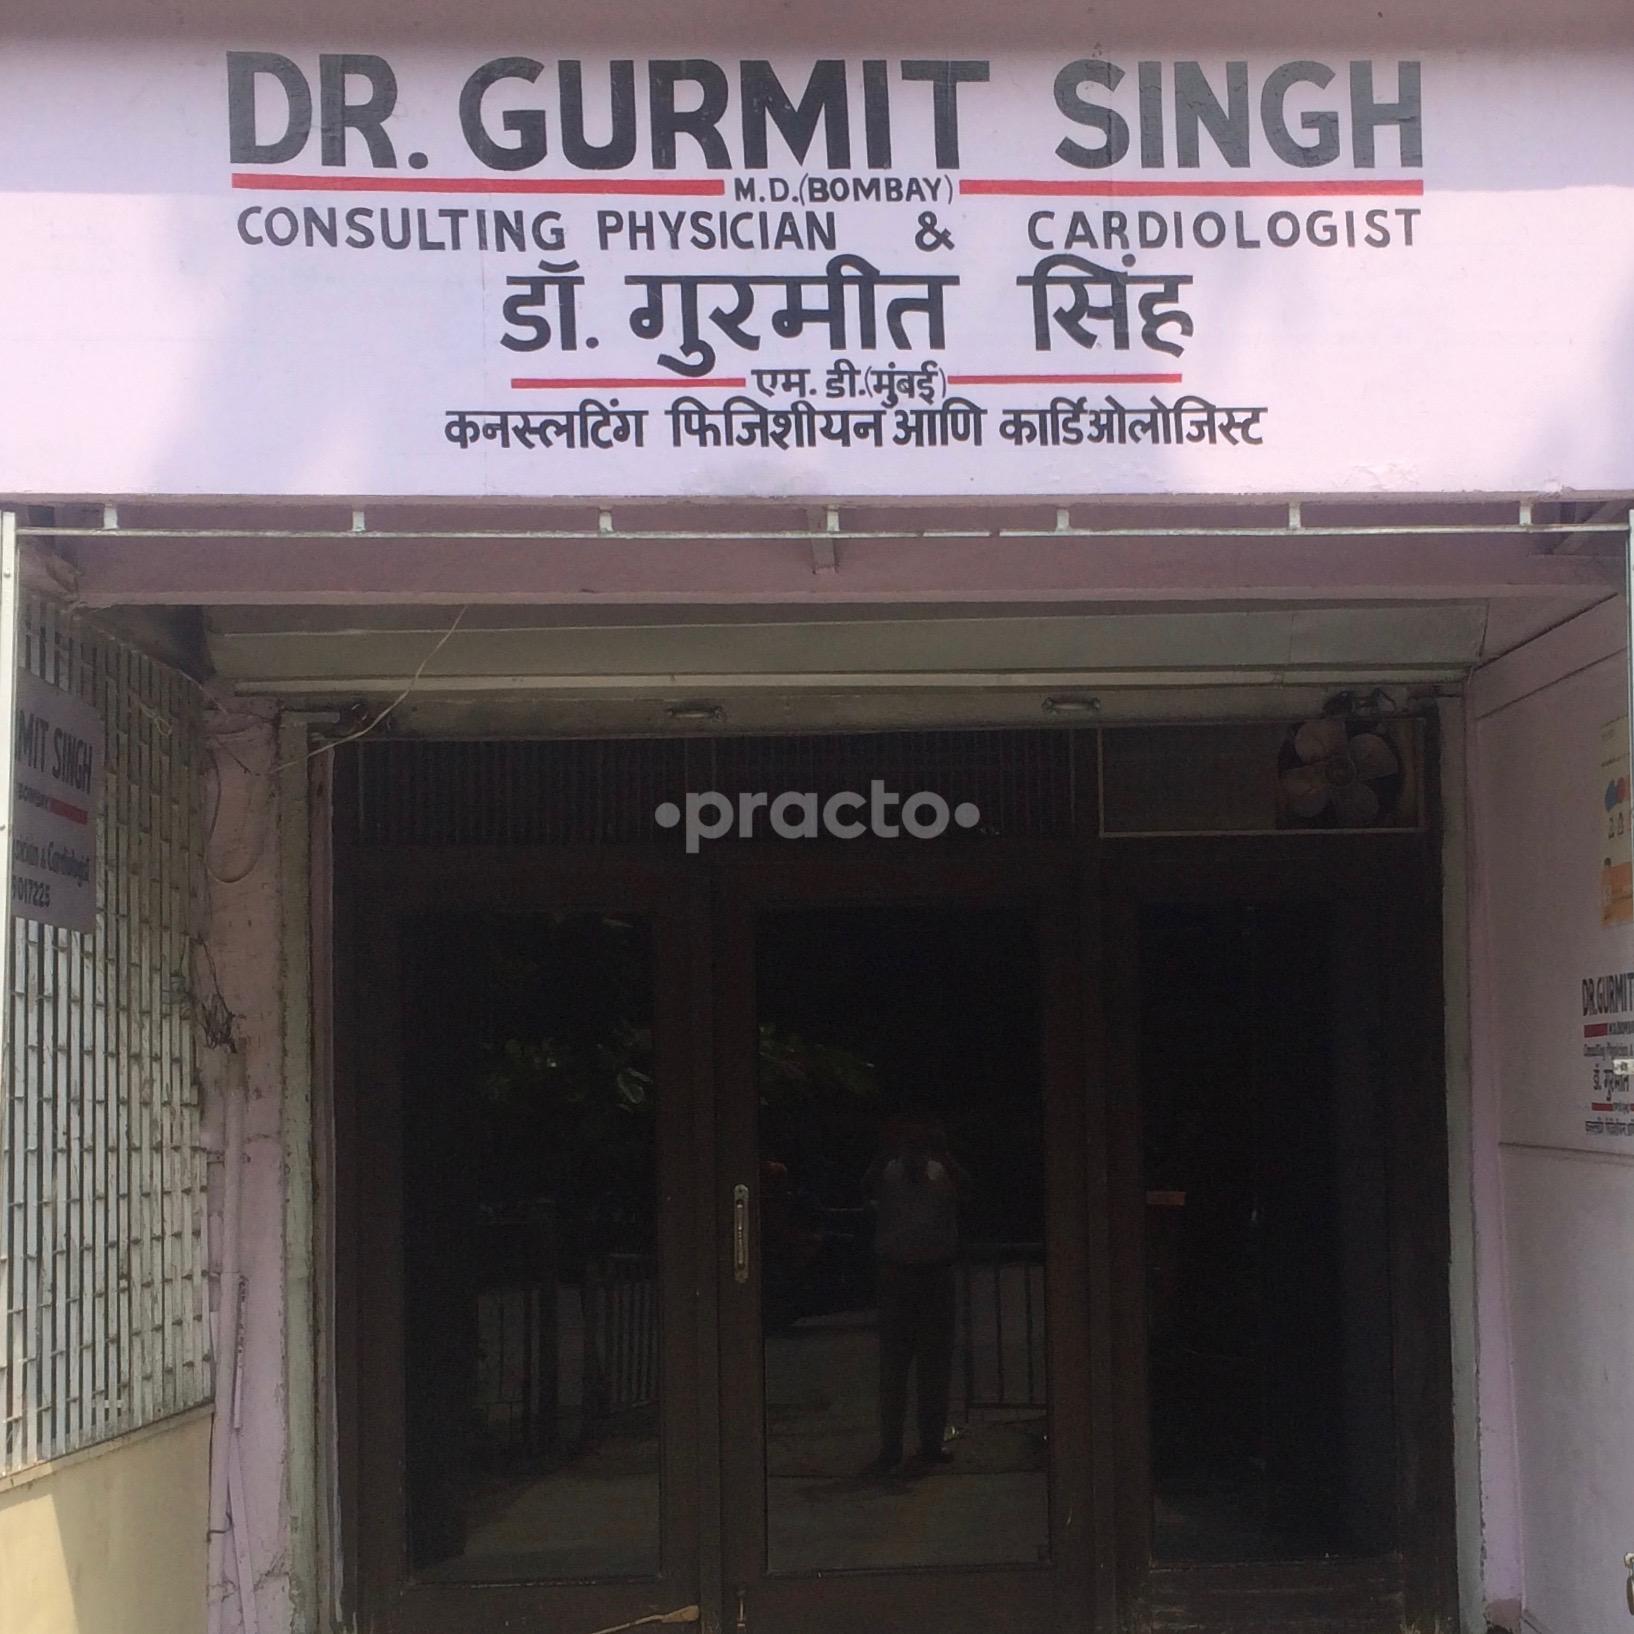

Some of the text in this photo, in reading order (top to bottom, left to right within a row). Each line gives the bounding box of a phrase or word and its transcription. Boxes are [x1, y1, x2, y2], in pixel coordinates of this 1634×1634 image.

[226, 51, 1423, 172] DR. GURMIT SINGH
[237, 206, 1421, 252] CONSULTING PHYSICIAN & CARDIOLOGIST
[624, 254, 960, 378] गुरमीत
[1016, 253, 1194, 358] सिंह
[664, 396, 887, 451] फिजिशीयन
[892, 396, 988, 447] आणि
[52, 727, 93, 795] SINGH
